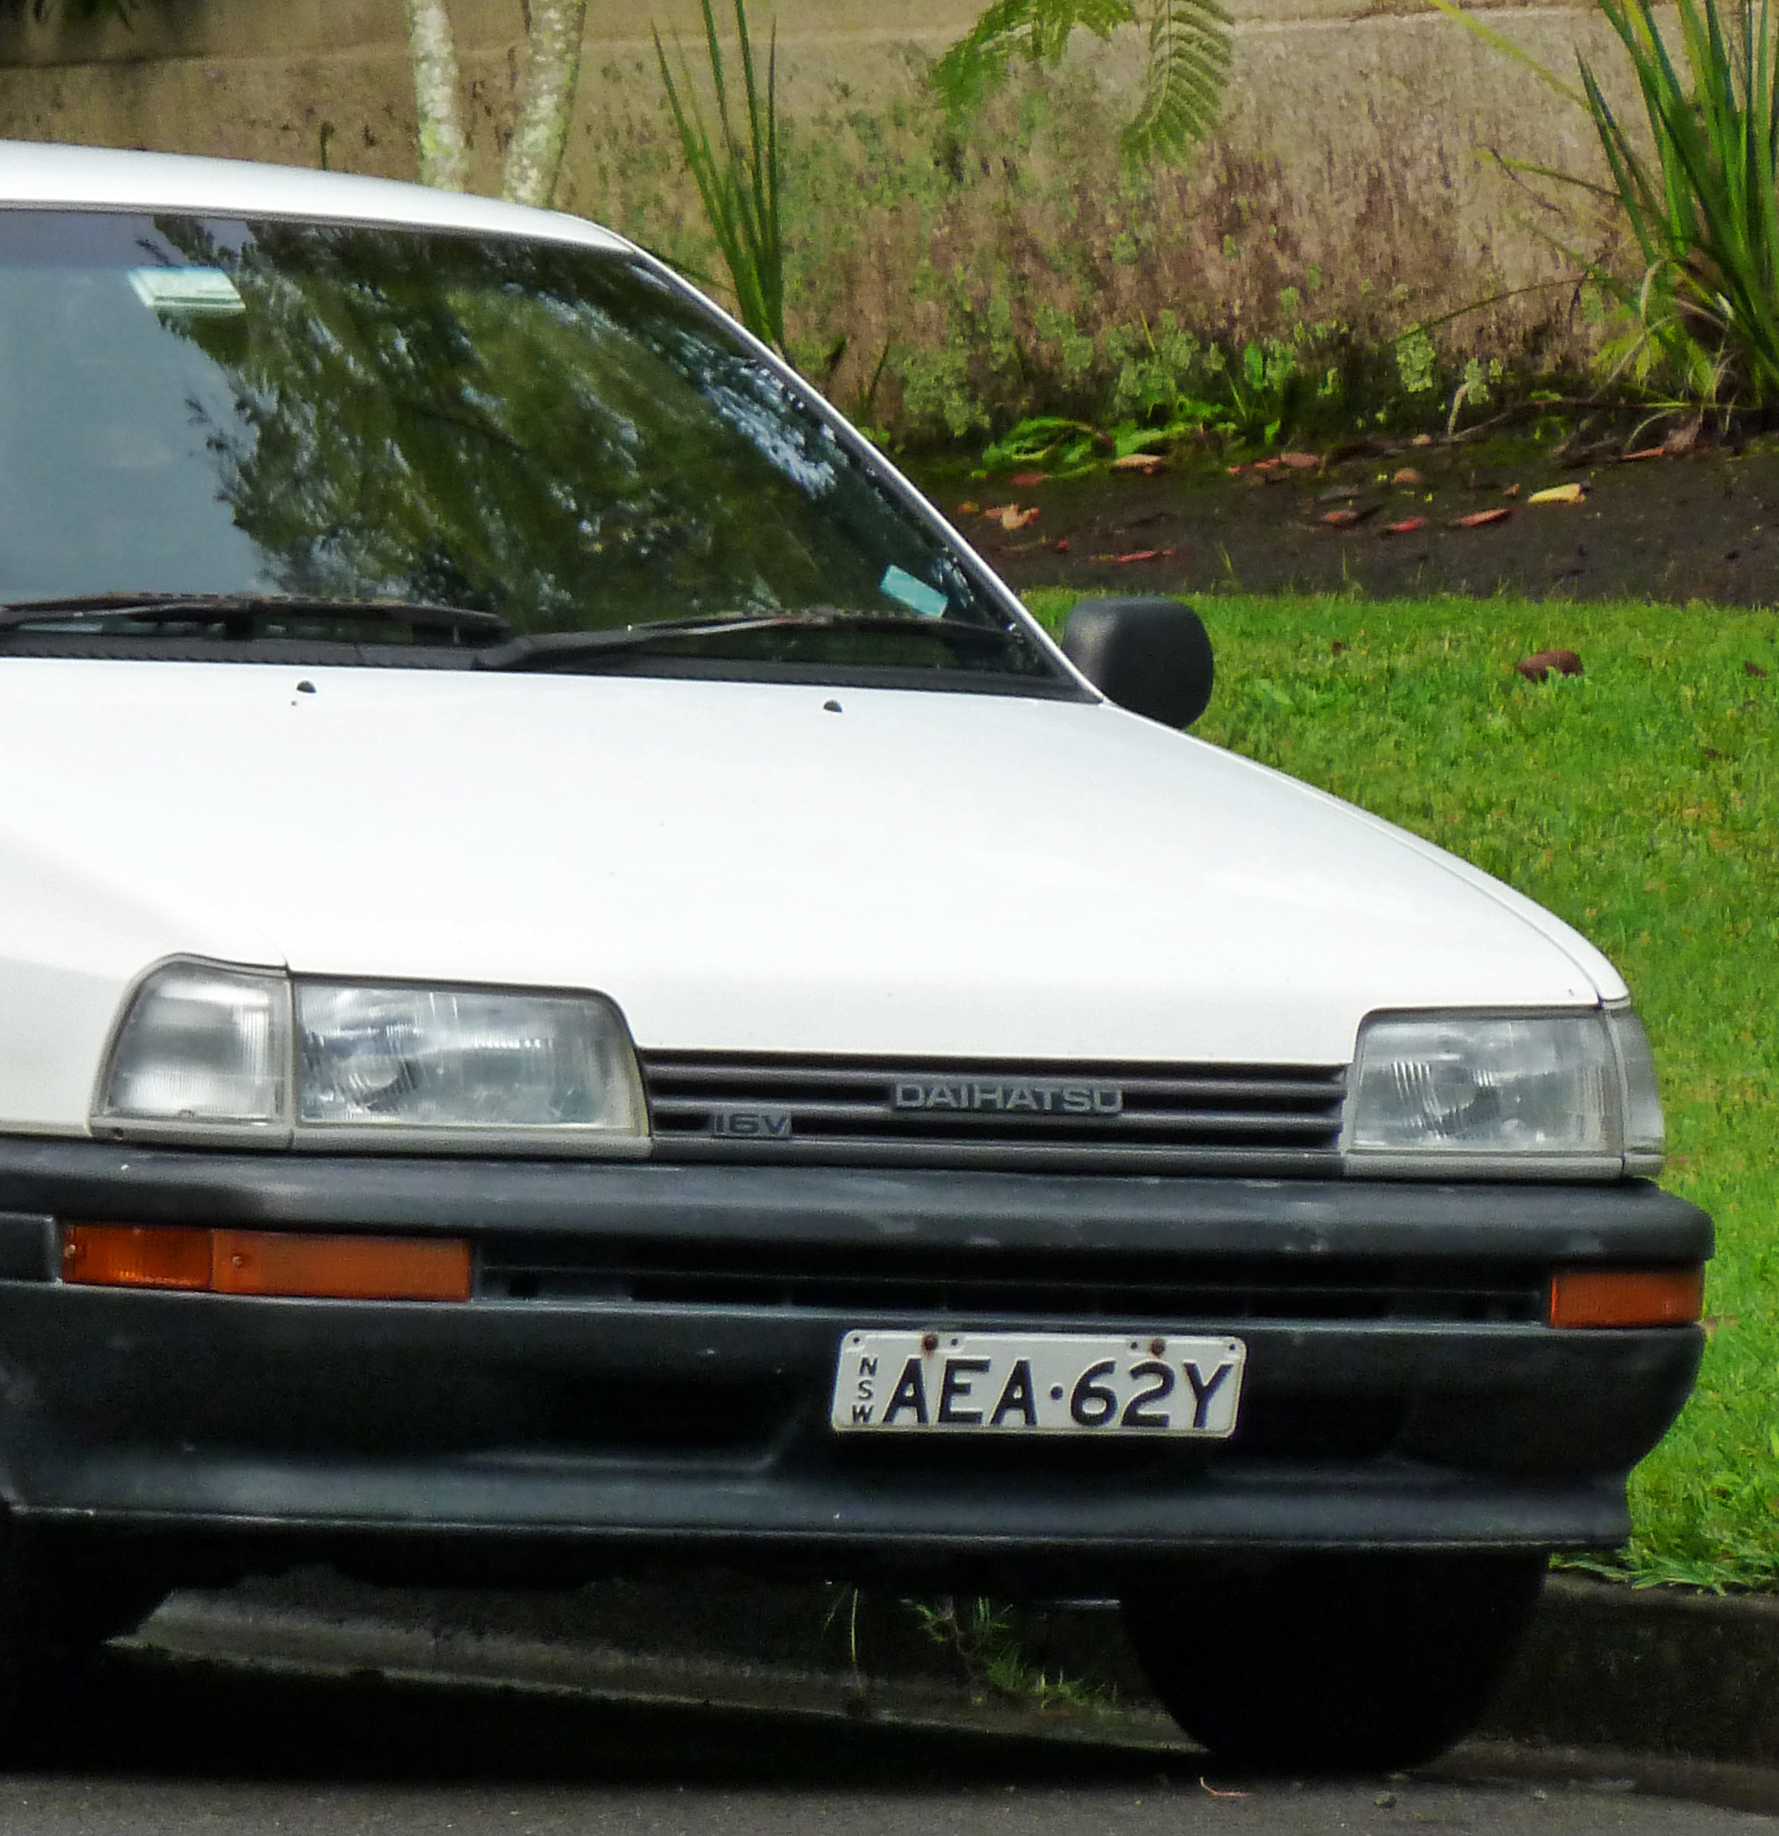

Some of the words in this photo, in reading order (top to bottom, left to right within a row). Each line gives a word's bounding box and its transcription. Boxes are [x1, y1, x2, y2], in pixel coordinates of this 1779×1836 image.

[896, 1083, 1123, 1113] DAIHATSU
[714, 1112, 789, 1134] 16V
[851, 1355, 878, 1424] NSW
